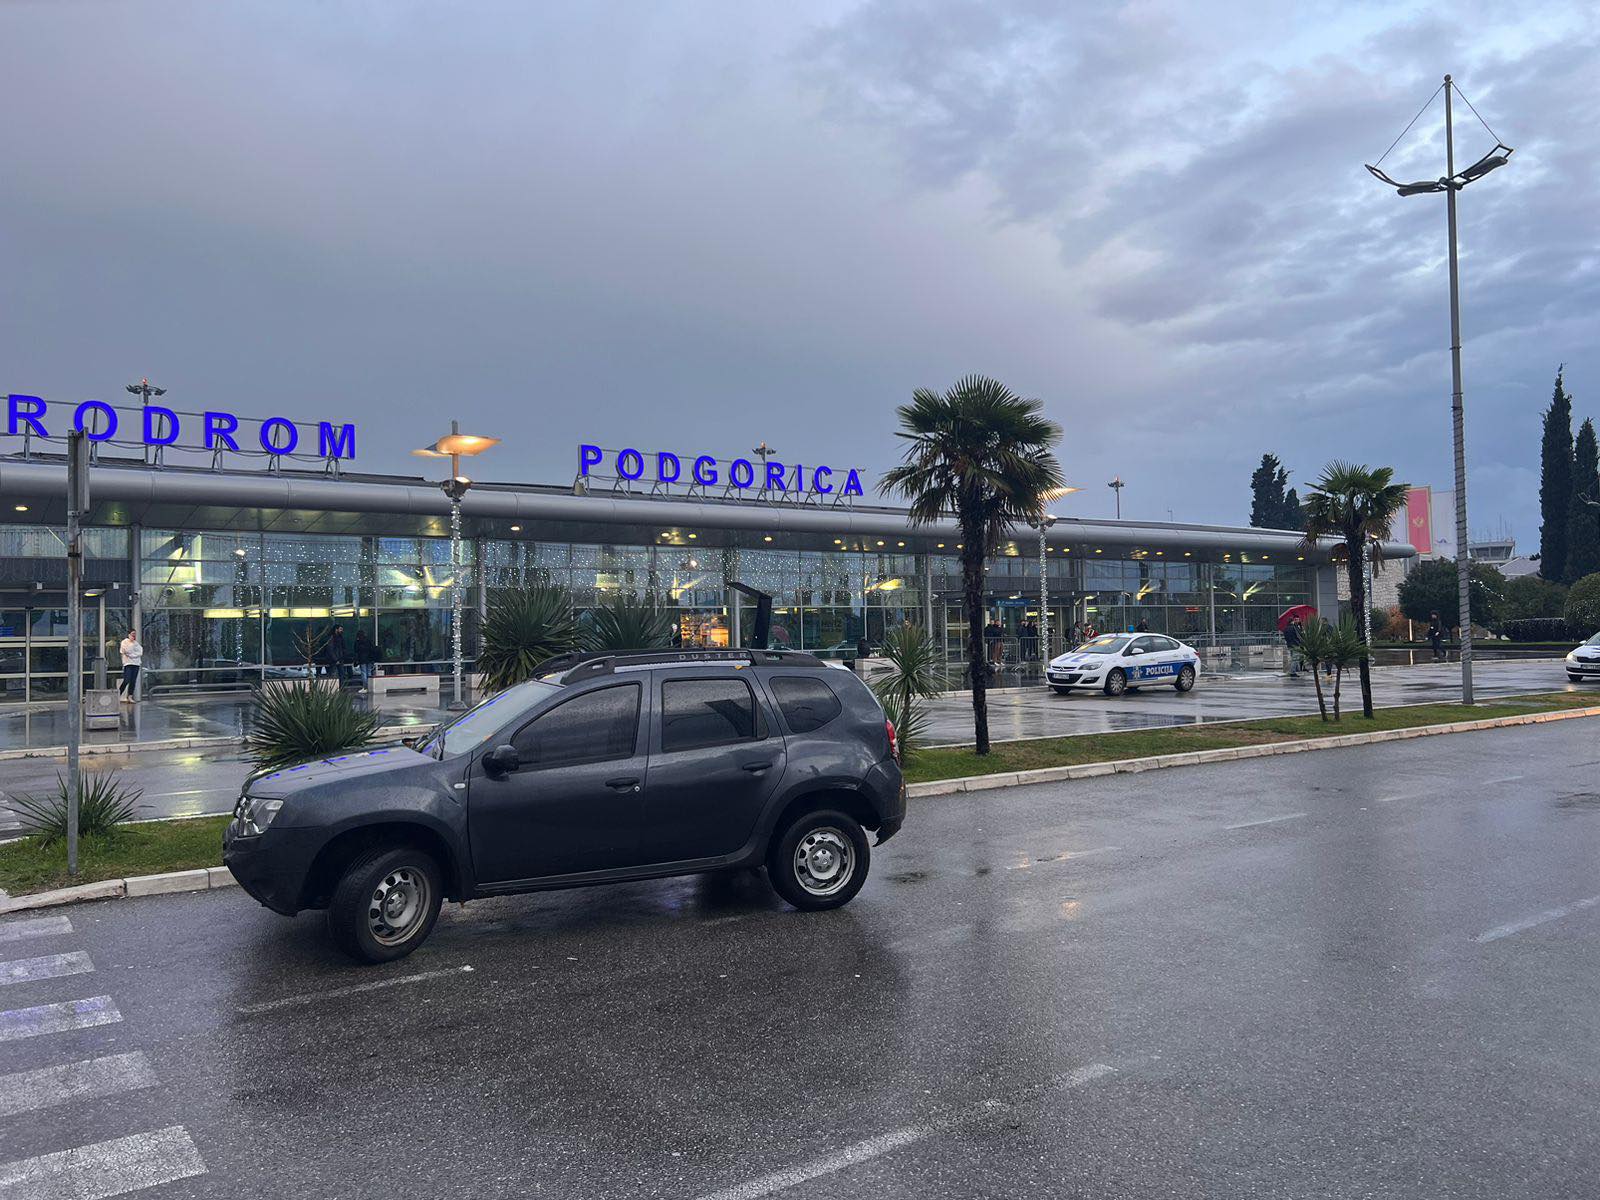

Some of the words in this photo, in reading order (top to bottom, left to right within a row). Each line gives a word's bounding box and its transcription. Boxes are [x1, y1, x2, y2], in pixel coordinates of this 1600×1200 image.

[8, 394, 356, 459] RODROM
[579, 444, 864, 496] PODGORICA
[679, 652, 747, 660] DUSTER
[1145, 665, 1174, 676] POLICIJA
